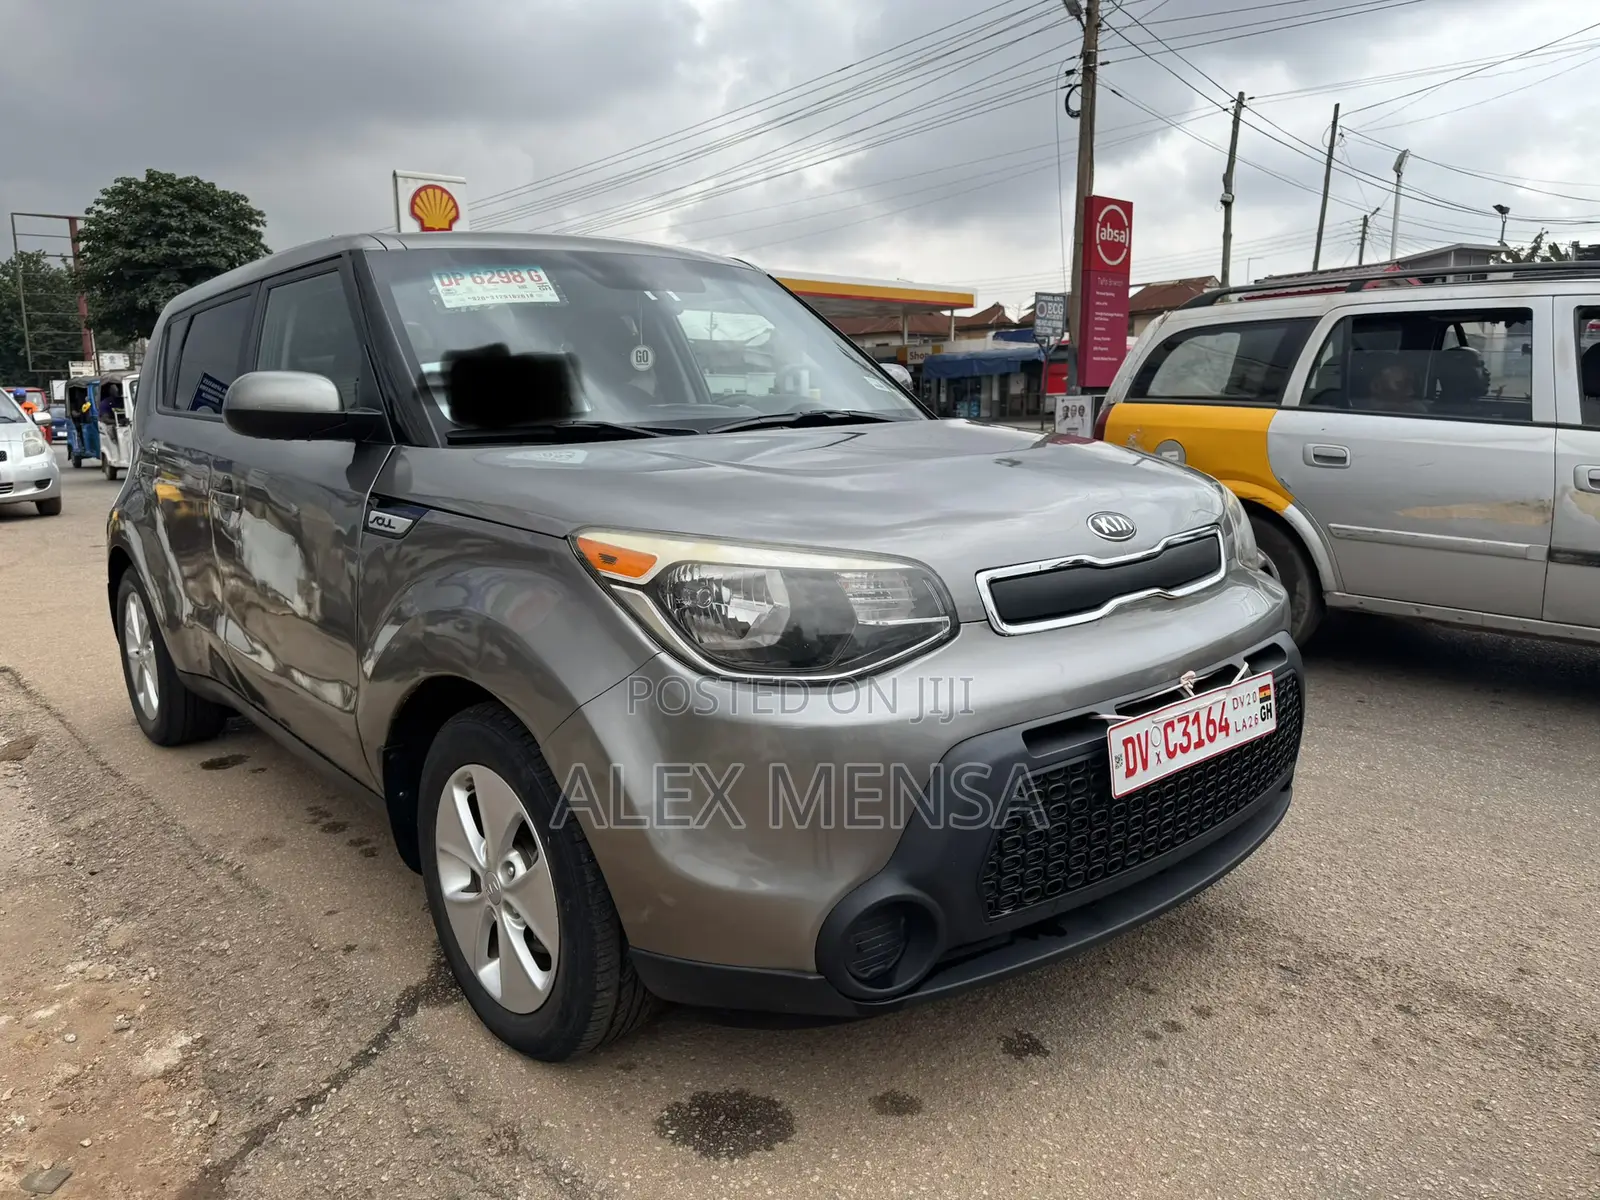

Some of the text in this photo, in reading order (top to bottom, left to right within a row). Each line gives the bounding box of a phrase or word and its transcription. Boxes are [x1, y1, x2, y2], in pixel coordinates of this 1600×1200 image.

[1100, 222, 1126, 243] absa
[437, 268, 543, 287] DP 6298 G
[1047, 302, 1064, 315] ECG
[635, 350, 649, 363] GO
[369, 516, 396, 530] SOUL
[1094, 516, 1134, 534] KIA
[1260, 702, 1273, 722] GH
[1121, 700, 1230, 779] DV C3164
